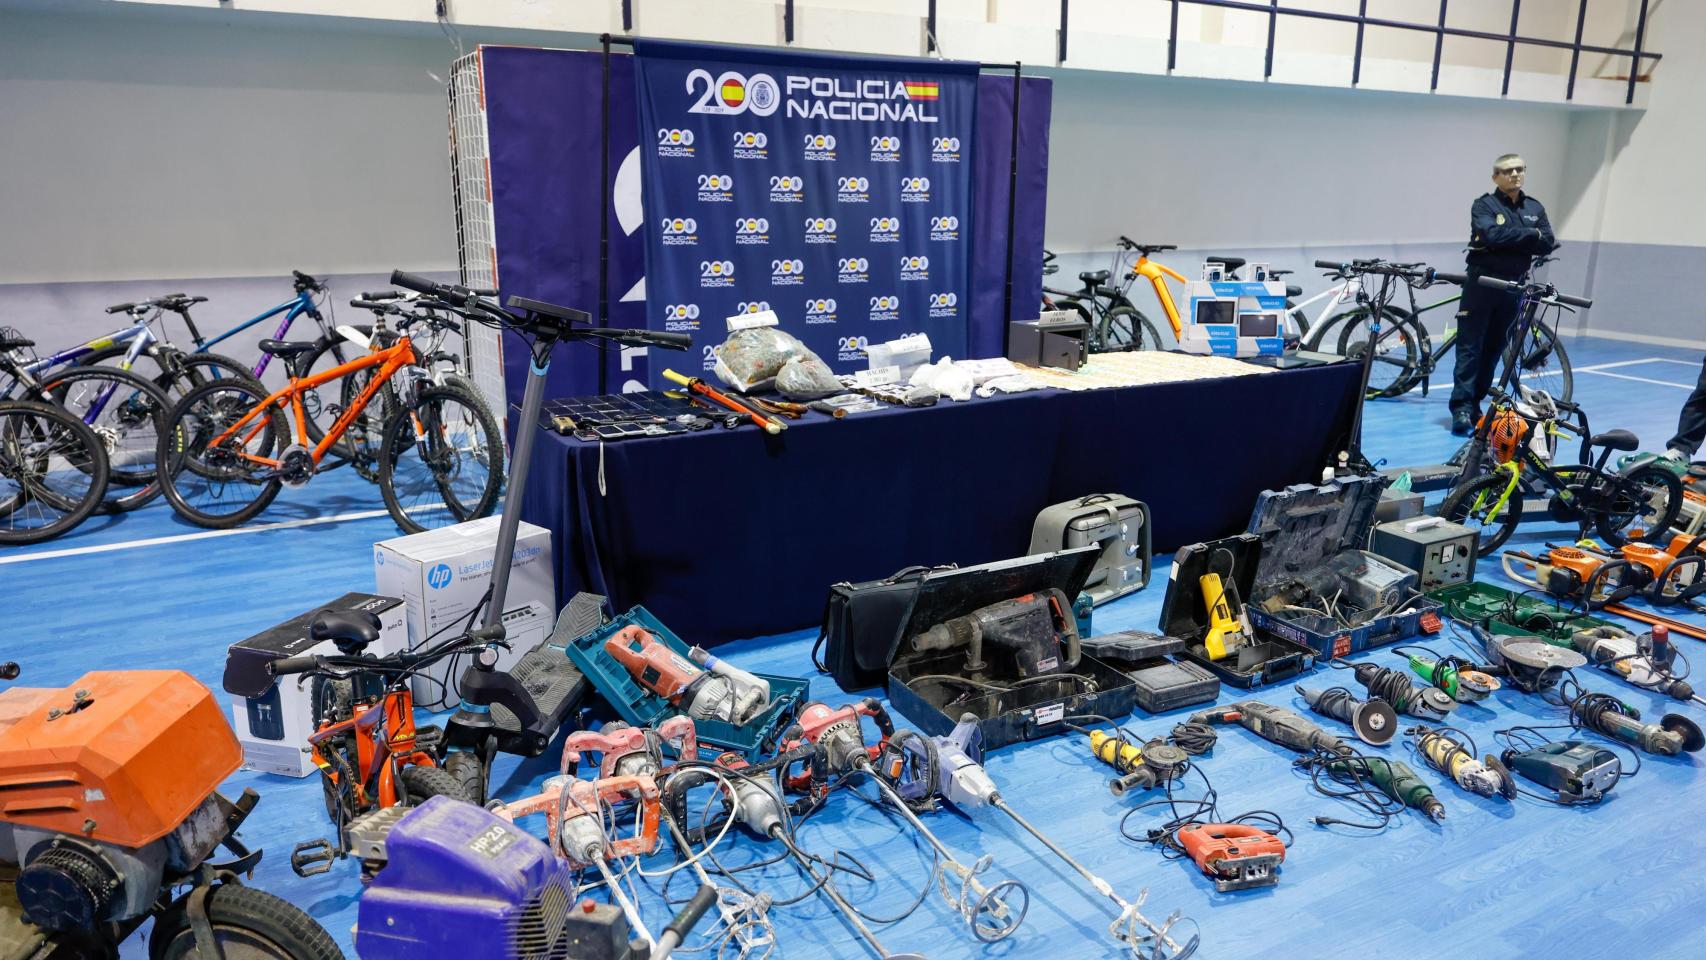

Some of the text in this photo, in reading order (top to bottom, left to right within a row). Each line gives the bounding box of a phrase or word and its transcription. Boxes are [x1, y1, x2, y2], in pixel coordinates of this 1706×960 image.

[686, 68, 781, 117] 200
[786, 99, 938, 123] NACIONAL
[658, 129, 694, 146] 200
[734, 132, 767, 148] 200
[805, 135, 836, 150] 200
[871, 136, 900, 152] 200
[932, 137, 960, 152] 200
[698, 175, 732, 191] 200
[770, 176, 803, 192] 200
[838, 177, 869, 192] 200
[902, 177, 929, 192] 200
[662, 218, 697, 234] 200
[736, 218, 769, 234] 200
[805, 218, 837, 233] 200
[871, 217, 899, 232] 200
[931, 216, 958, 231] 200
[701, 261, 734, 277] 200
[772, 259, 803, 275] 200
[839, 258, 868, 273] 200
[901, 256, 929, 271] 200
[806, 299, 837, 314] 200
[870, 296, 899, 311] 200
[930, 293, 957, 307] 200
[666, 304, 699, 320] 200
[839, 336, 868, 351] 200
[430, 566, 450, 590] hp
